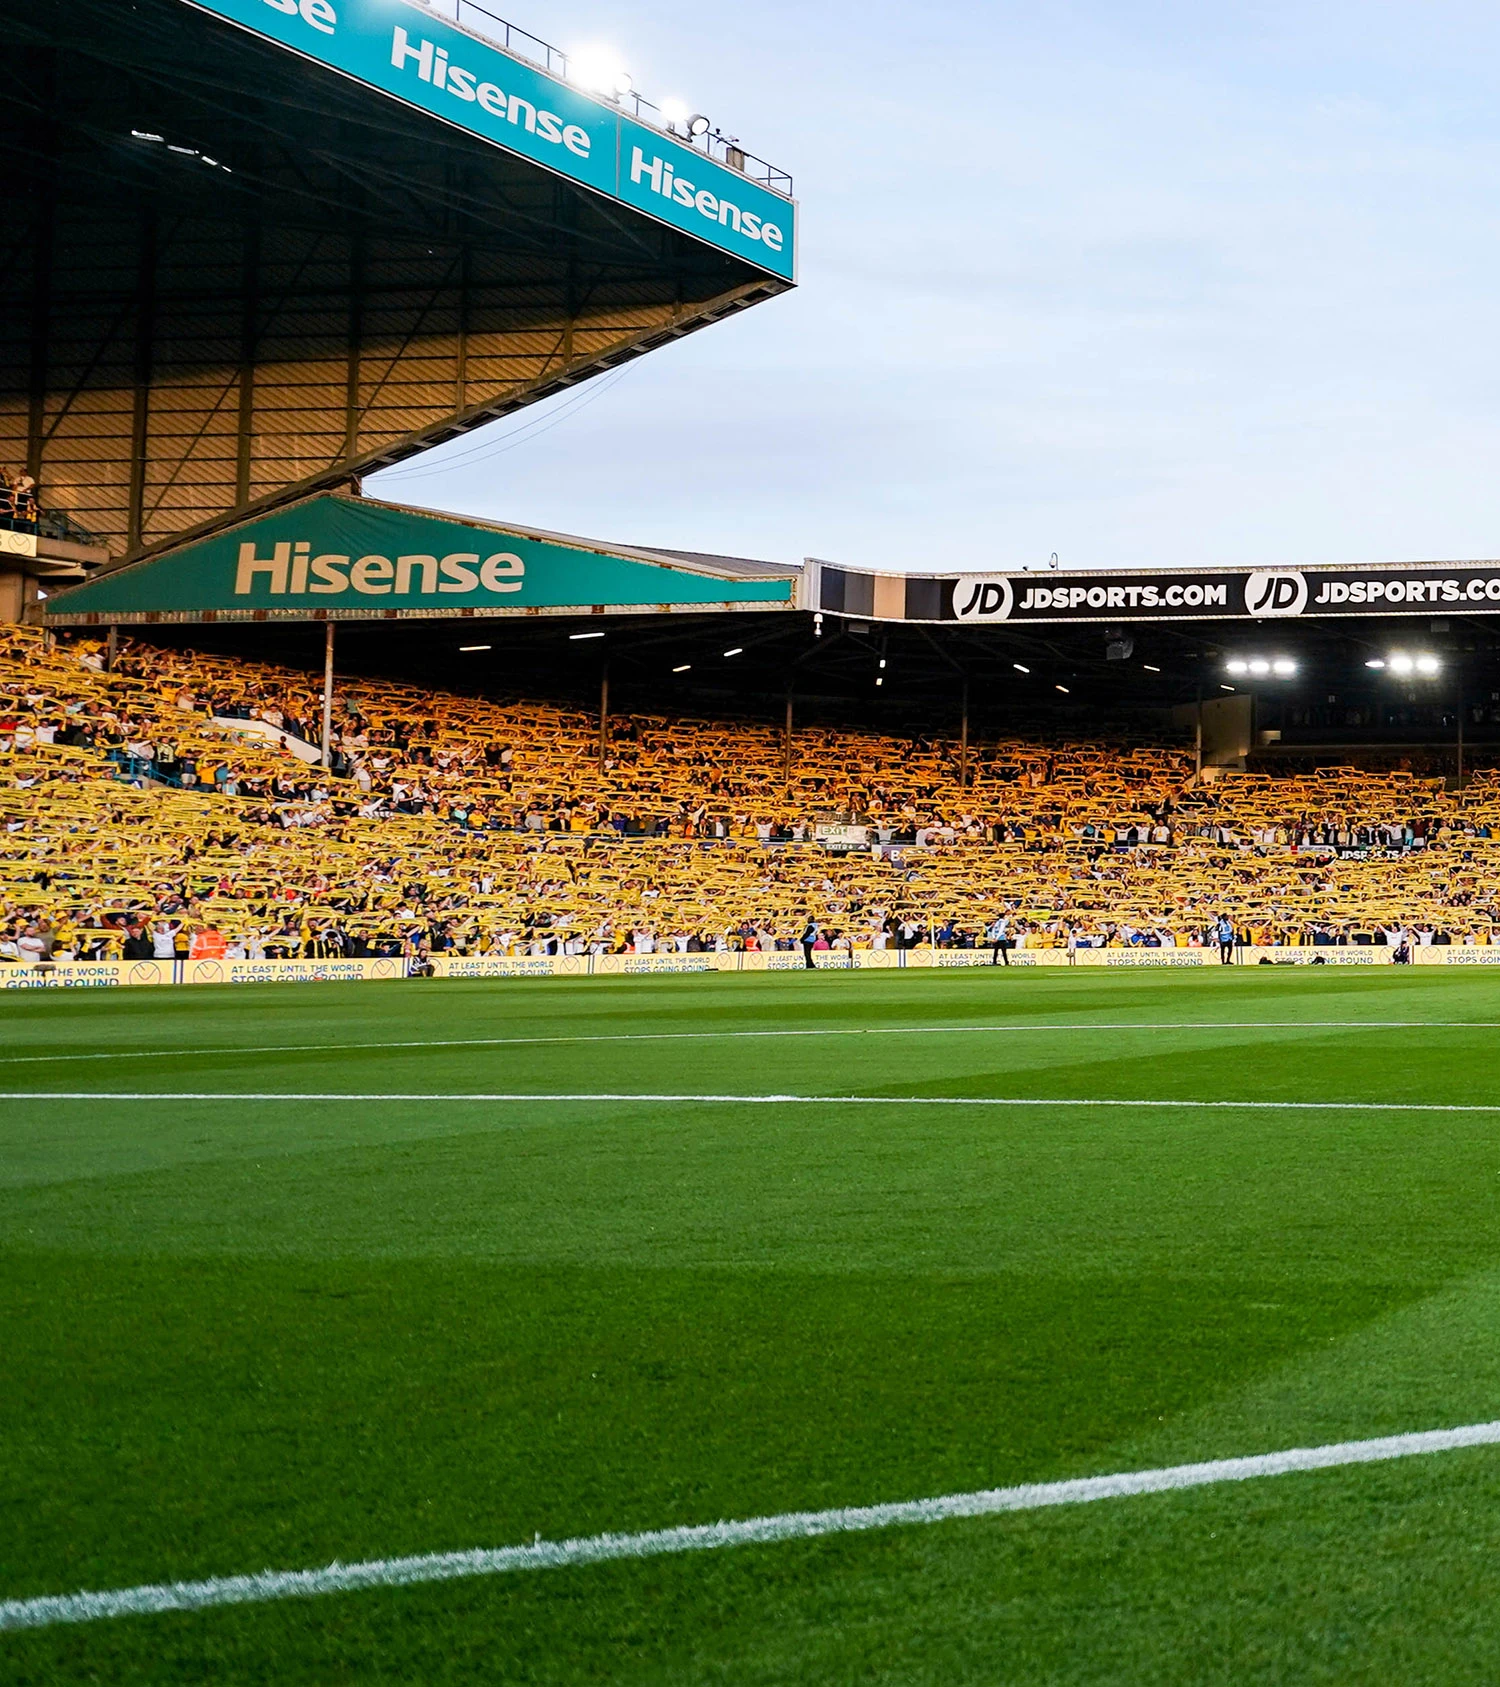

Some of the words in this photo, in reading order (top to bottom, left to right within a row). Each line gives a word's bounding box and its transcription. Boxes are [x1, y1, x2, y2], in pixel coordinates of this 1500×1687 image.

[391, 26, 591, 160] Hisense
[630, 146, 784, 253] Hisense
[234, 540, 526, 596] Hisense
[961, 583, 1004, 615] JD
[1019, 584, 1227, 609] JDSPORTS.COM
[1254, 578, 1298, 610] JD
[822, 826, 847, 836] EXIT
[77, 968, 119, 976] WORLD
